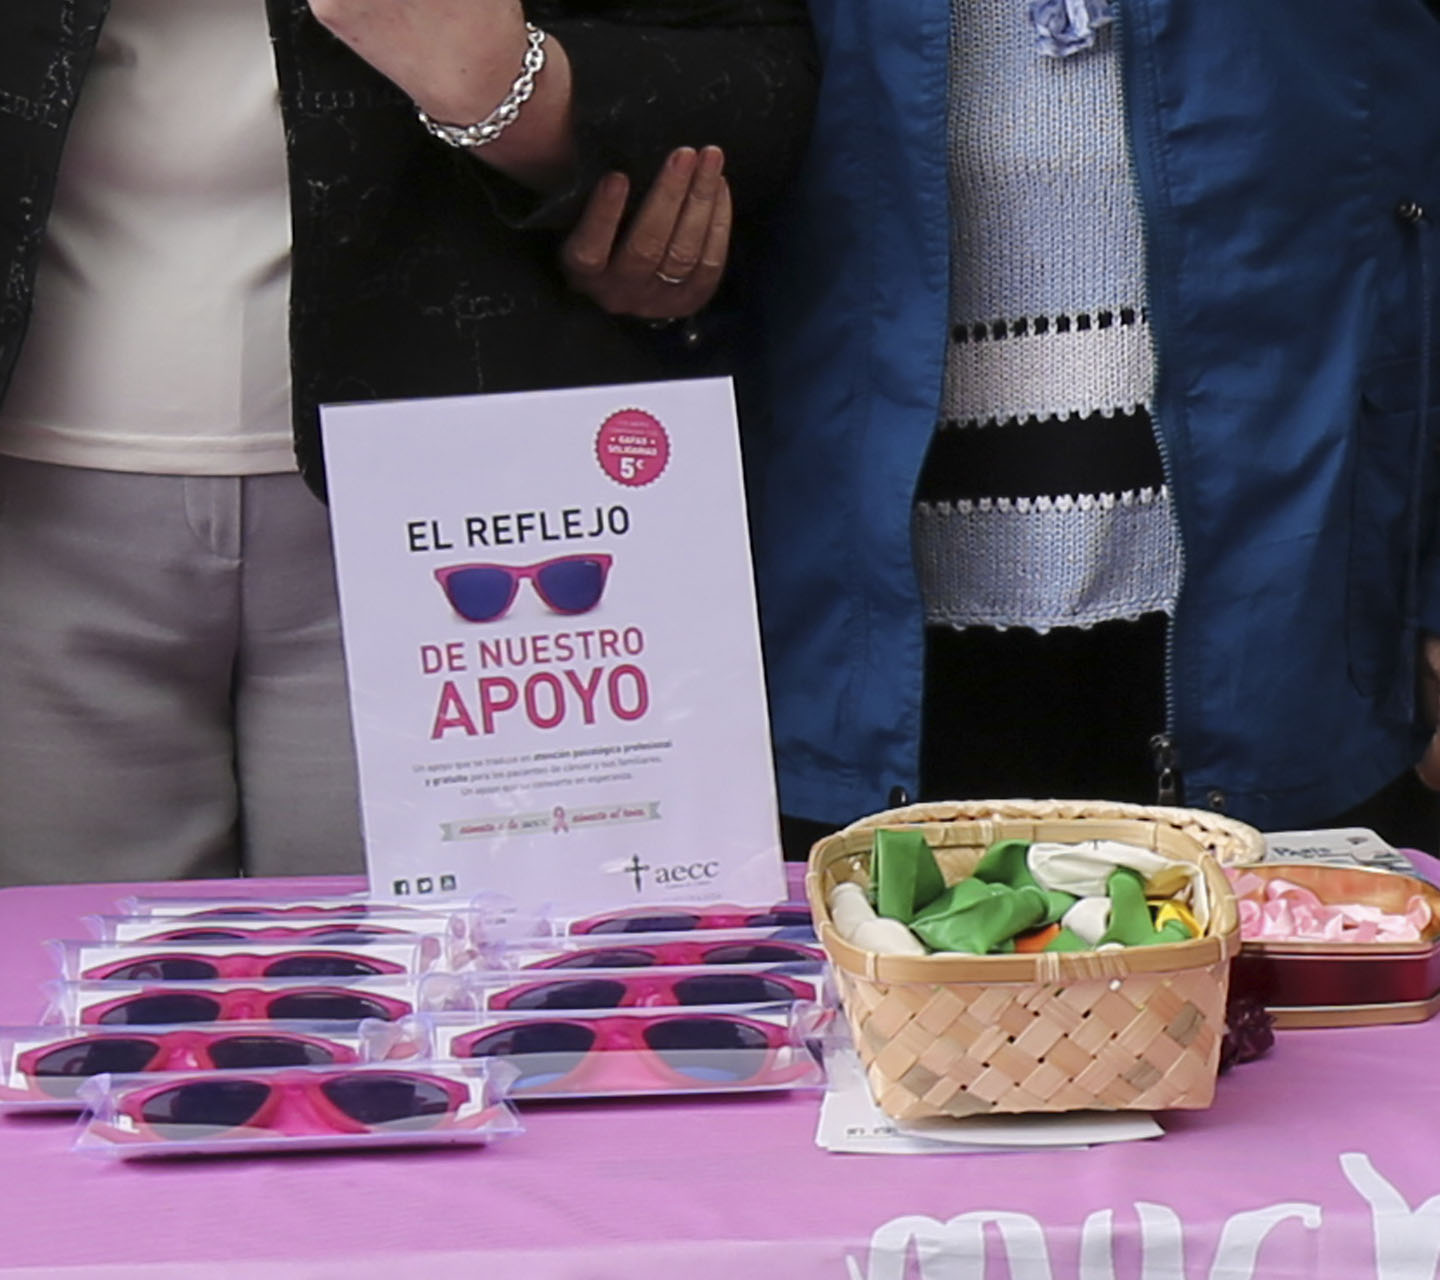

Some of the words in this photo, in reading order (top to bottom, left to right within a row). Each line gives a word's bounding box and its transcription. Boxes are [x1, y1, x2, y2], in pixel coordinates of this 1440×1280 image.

[407, 520, 453, 552] EL
[466, 505, 630, 548] REFLEJO
[420, 642, 467, 674] DE
[478, 626, 644, 669] NUESTRO
[431, 663, 649, 740] APOYO
[655, 861, 720, 884] aecc
